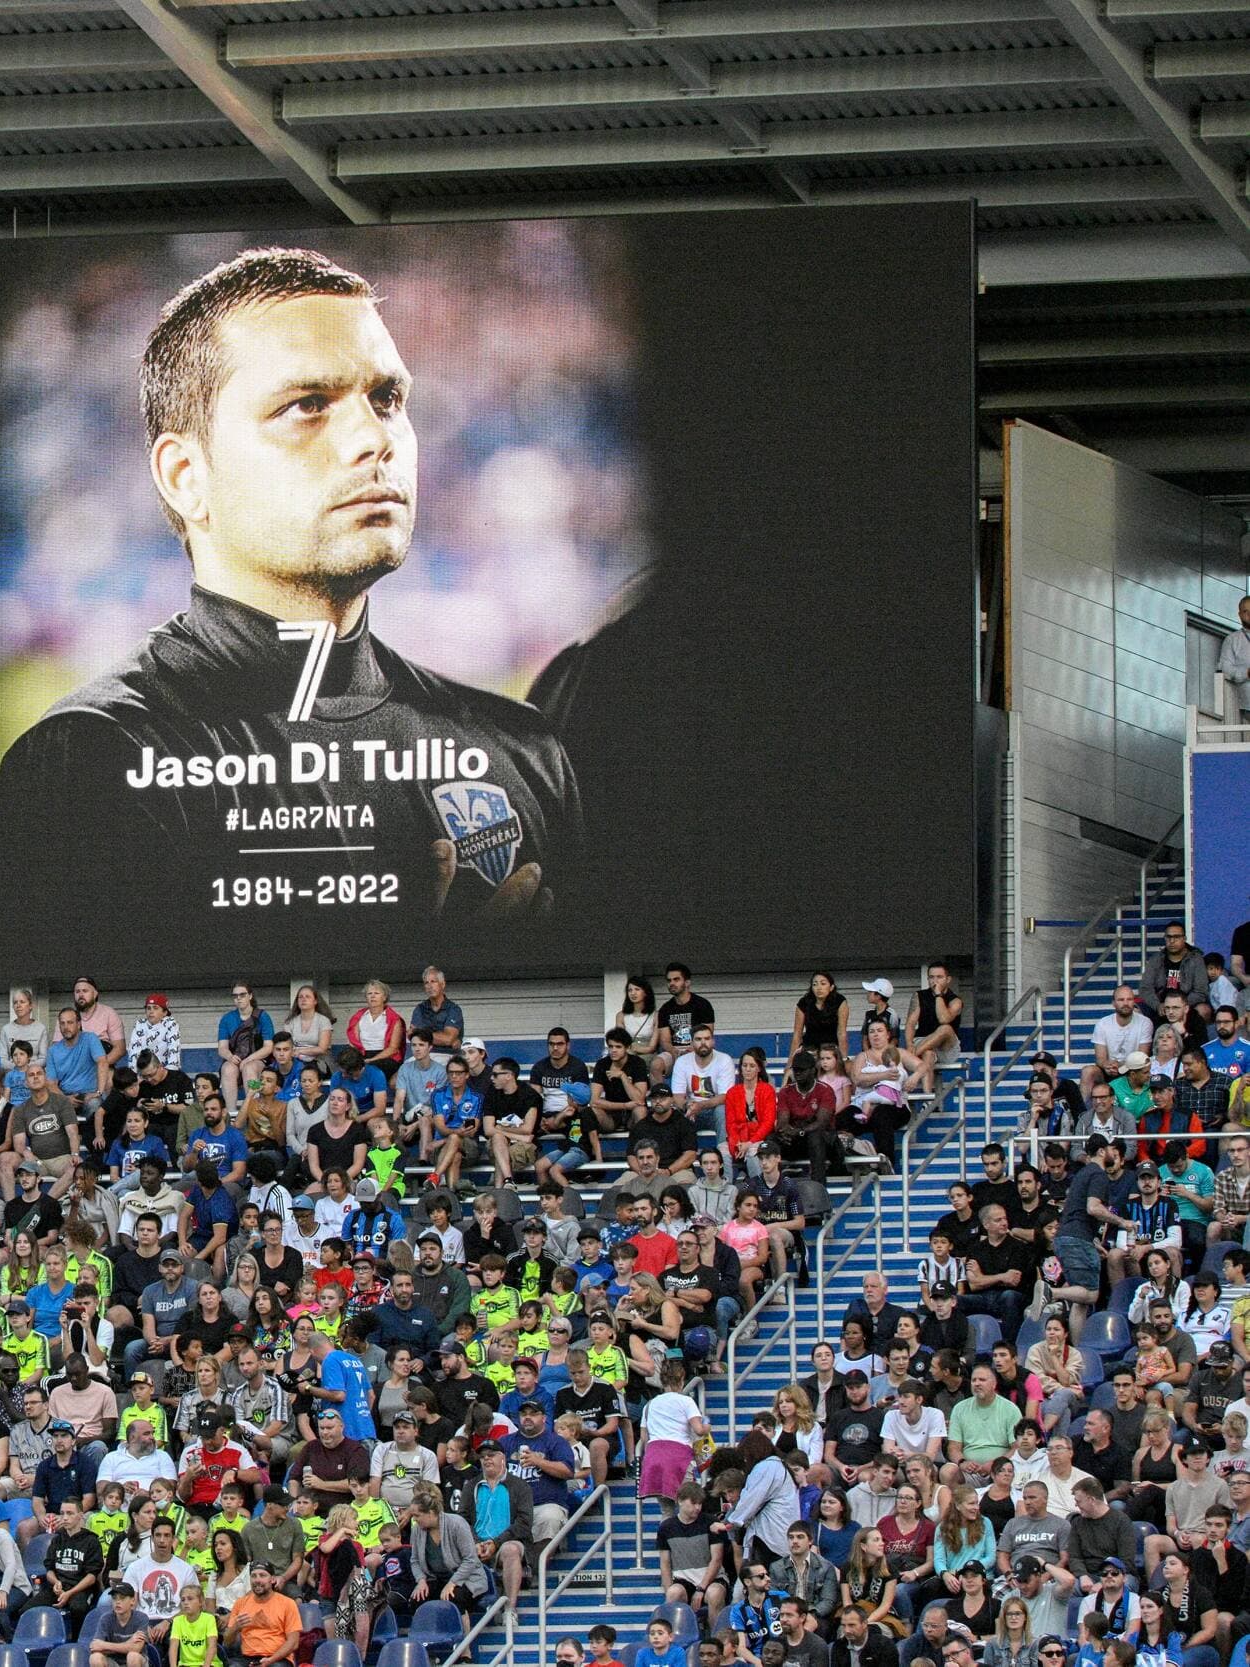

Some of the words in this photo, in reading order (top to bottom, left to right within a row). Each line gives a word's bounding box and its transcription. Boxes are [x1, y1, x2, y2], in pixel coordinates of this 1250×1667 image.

[276, 620, 337, 722] 7
[126, 746, 276, 788] Jason
[291, 741, 340, 783] Di
[352, 738, 490, 782] Tullio
[225, 804, 374, 832] #LAGR7NTA
[212, 874, 399, 907] 1984-2022
[18, 1452, 40, 1461] BMO
[1014, 1532, 1055, 1543] HURLEY
[561, 1573, 593, 1582] STION
